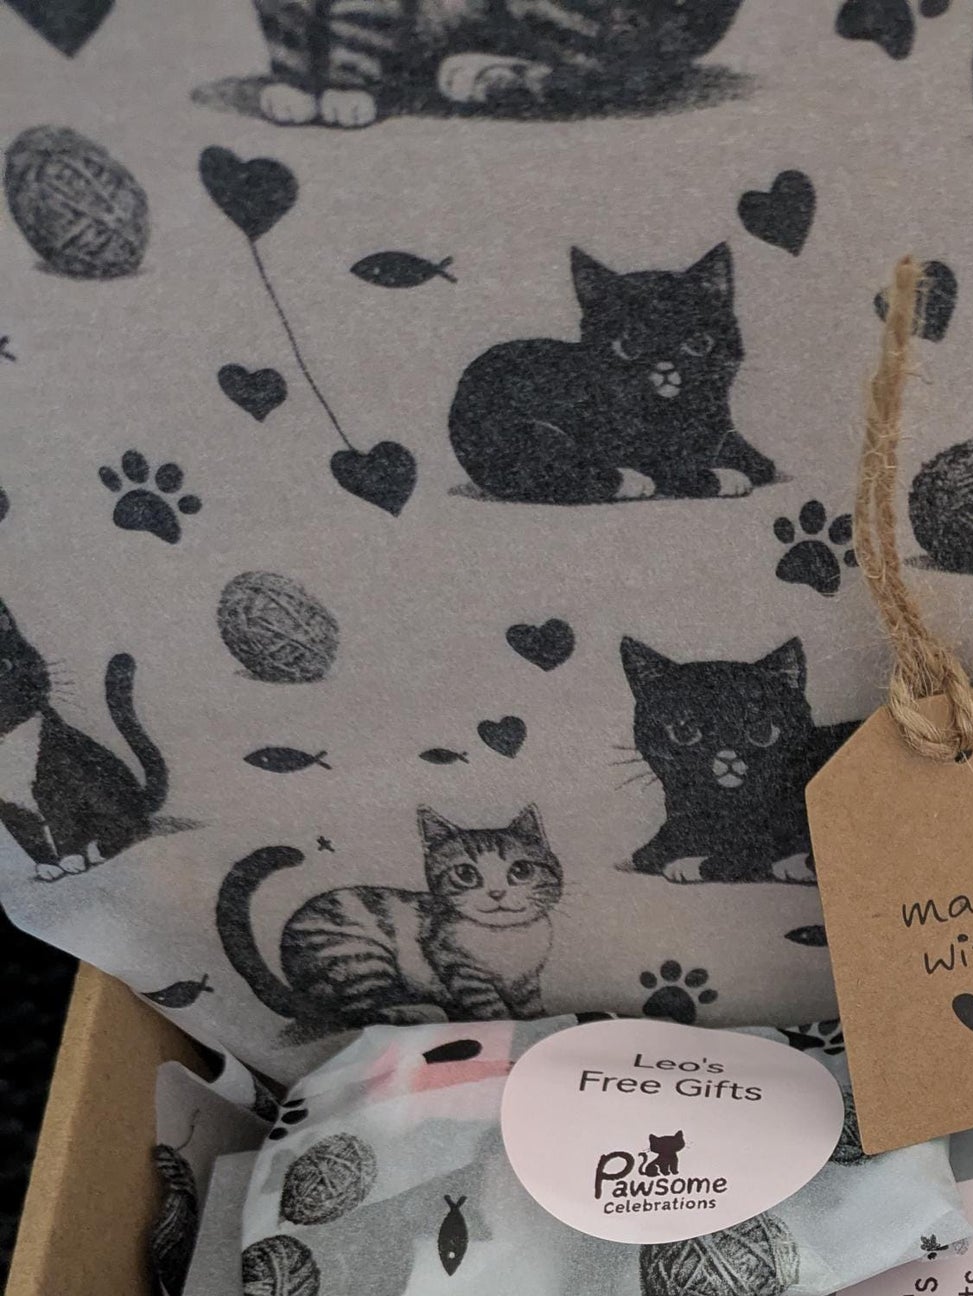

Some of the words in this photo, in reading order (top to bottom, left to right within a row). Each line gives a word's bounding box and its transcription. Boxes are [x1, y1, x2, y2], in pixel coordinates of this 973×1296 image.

[633, 1053, 725, 1074] Leo's
[579, 1070, 661, 1095] Free
[675, 1077, 763, 1101] Gifts
[594, 1151, 728, 1200] Pawsome
[603, 1197, 716, 1215] Celebrations
